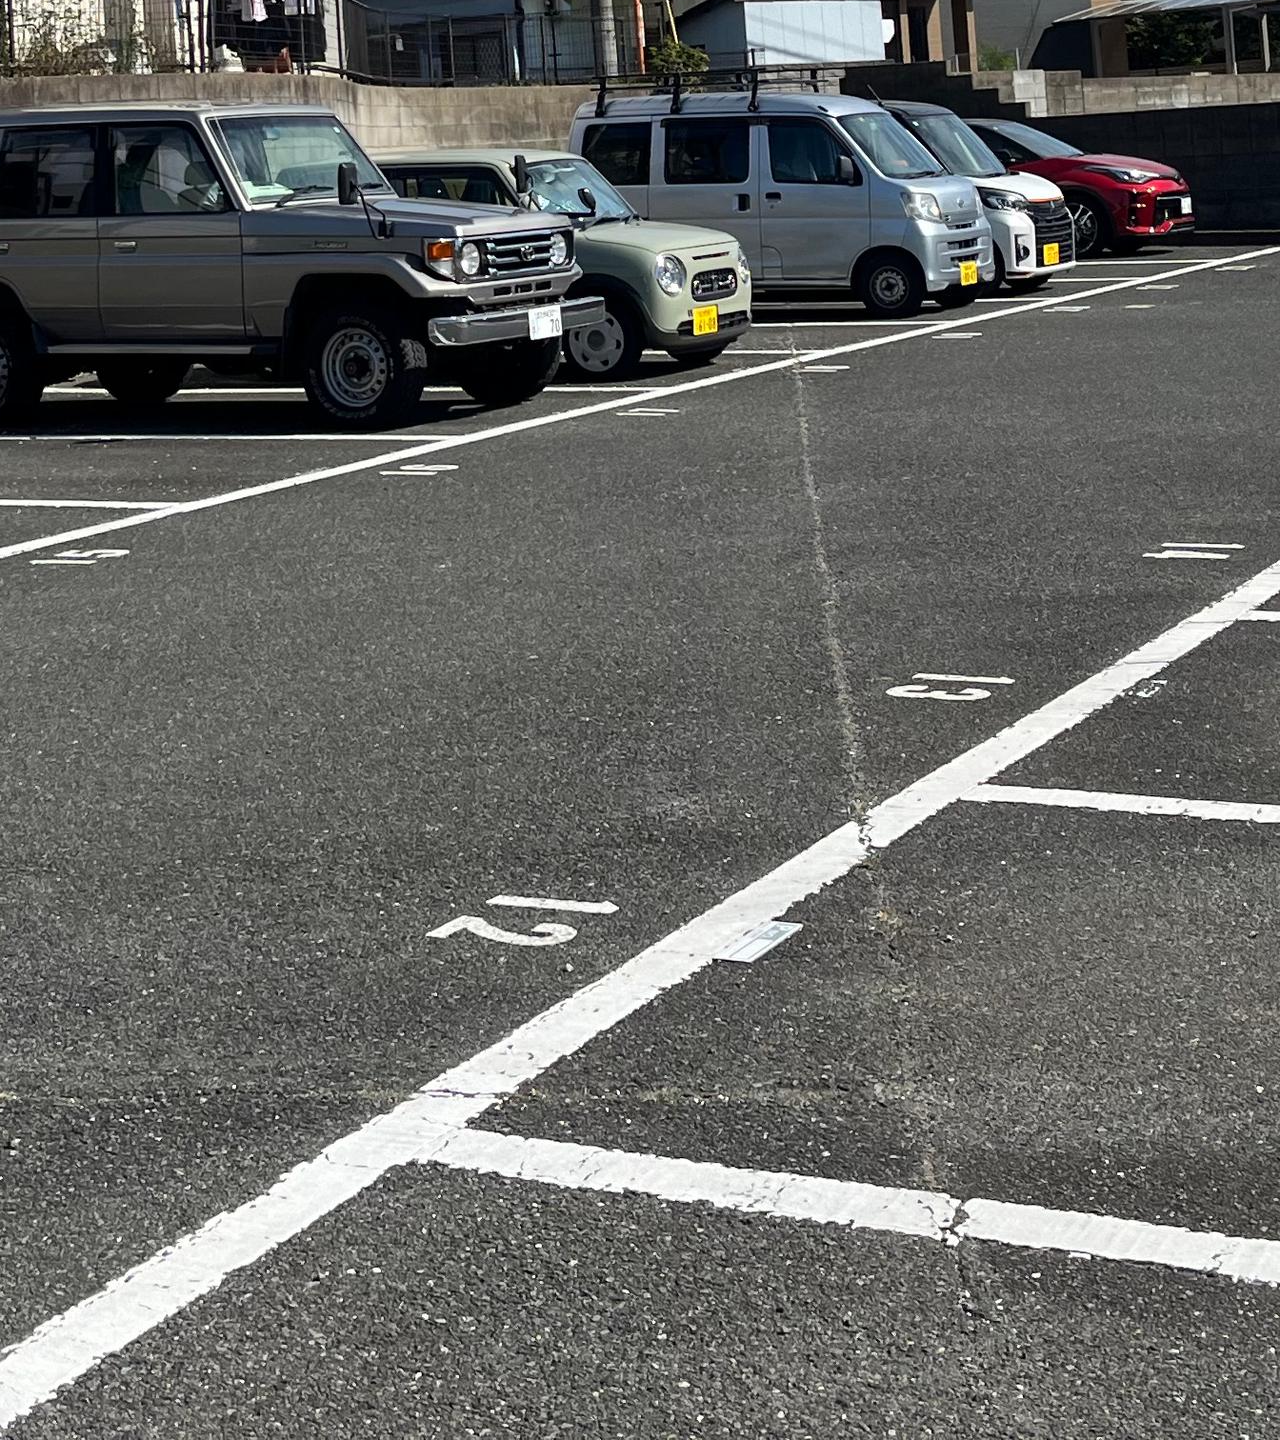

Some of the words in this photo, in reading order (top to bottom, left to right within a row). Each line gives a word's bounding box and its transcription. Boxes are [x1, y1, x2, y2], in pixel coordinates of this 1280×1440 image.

[29, 548, 131, 566] 15
[885, 673, 1016, 702] 13
[426, 894, 620, 947] 12
